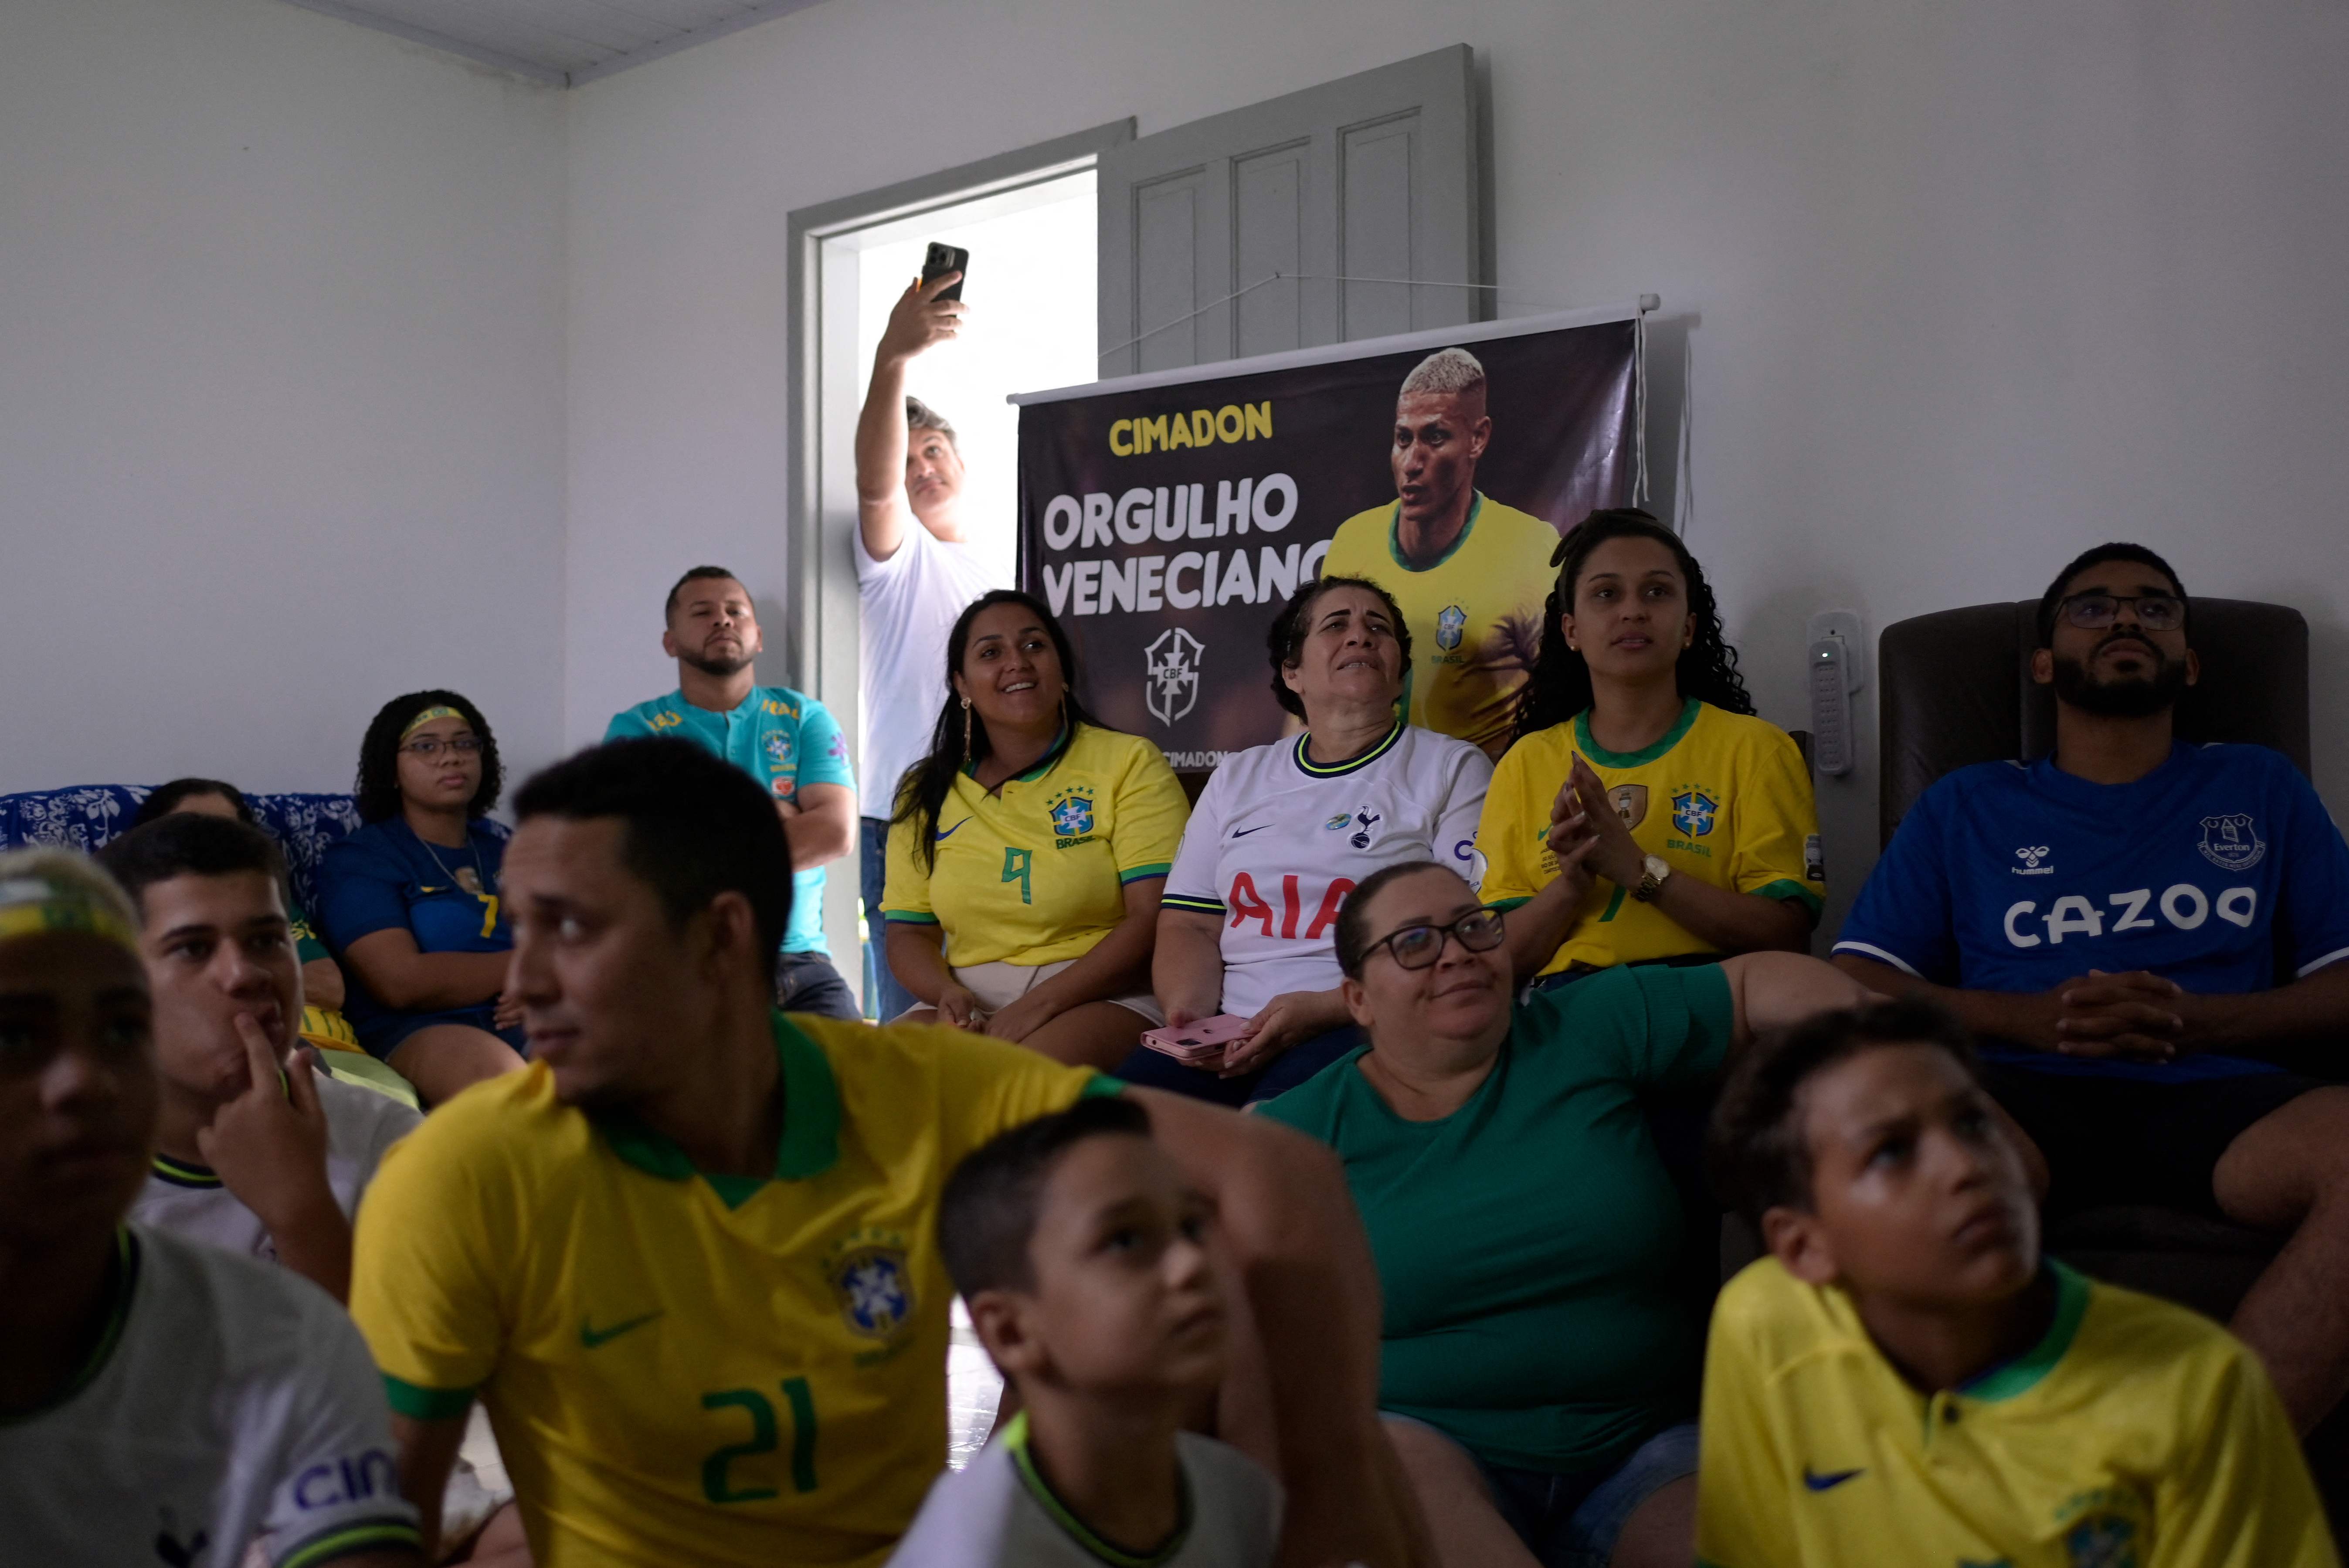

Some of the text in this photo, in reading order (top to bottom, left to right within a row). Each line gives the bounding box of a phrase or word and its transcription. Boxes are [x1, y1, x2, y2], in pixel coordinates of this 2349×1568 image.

[1109, 400, 1273, 457] CIMADON
[1043, 472, 1298, 551] ORGULHO
[1163, 668, 1182, 679] CBF
[1432, 655, 1465, 664] BRASIL
[1065, 814, 1081, 822] CBF
[1667, 839, 1712, 858] BRASIL
[2011, 865, 2054, 875] hummel
[1001, 847, 1033, 905] 9
[479, 894, 499, 937] 7
[2004, 883, 2257, 948] CAZOO
[702, 1376, 818, 1504] 21
